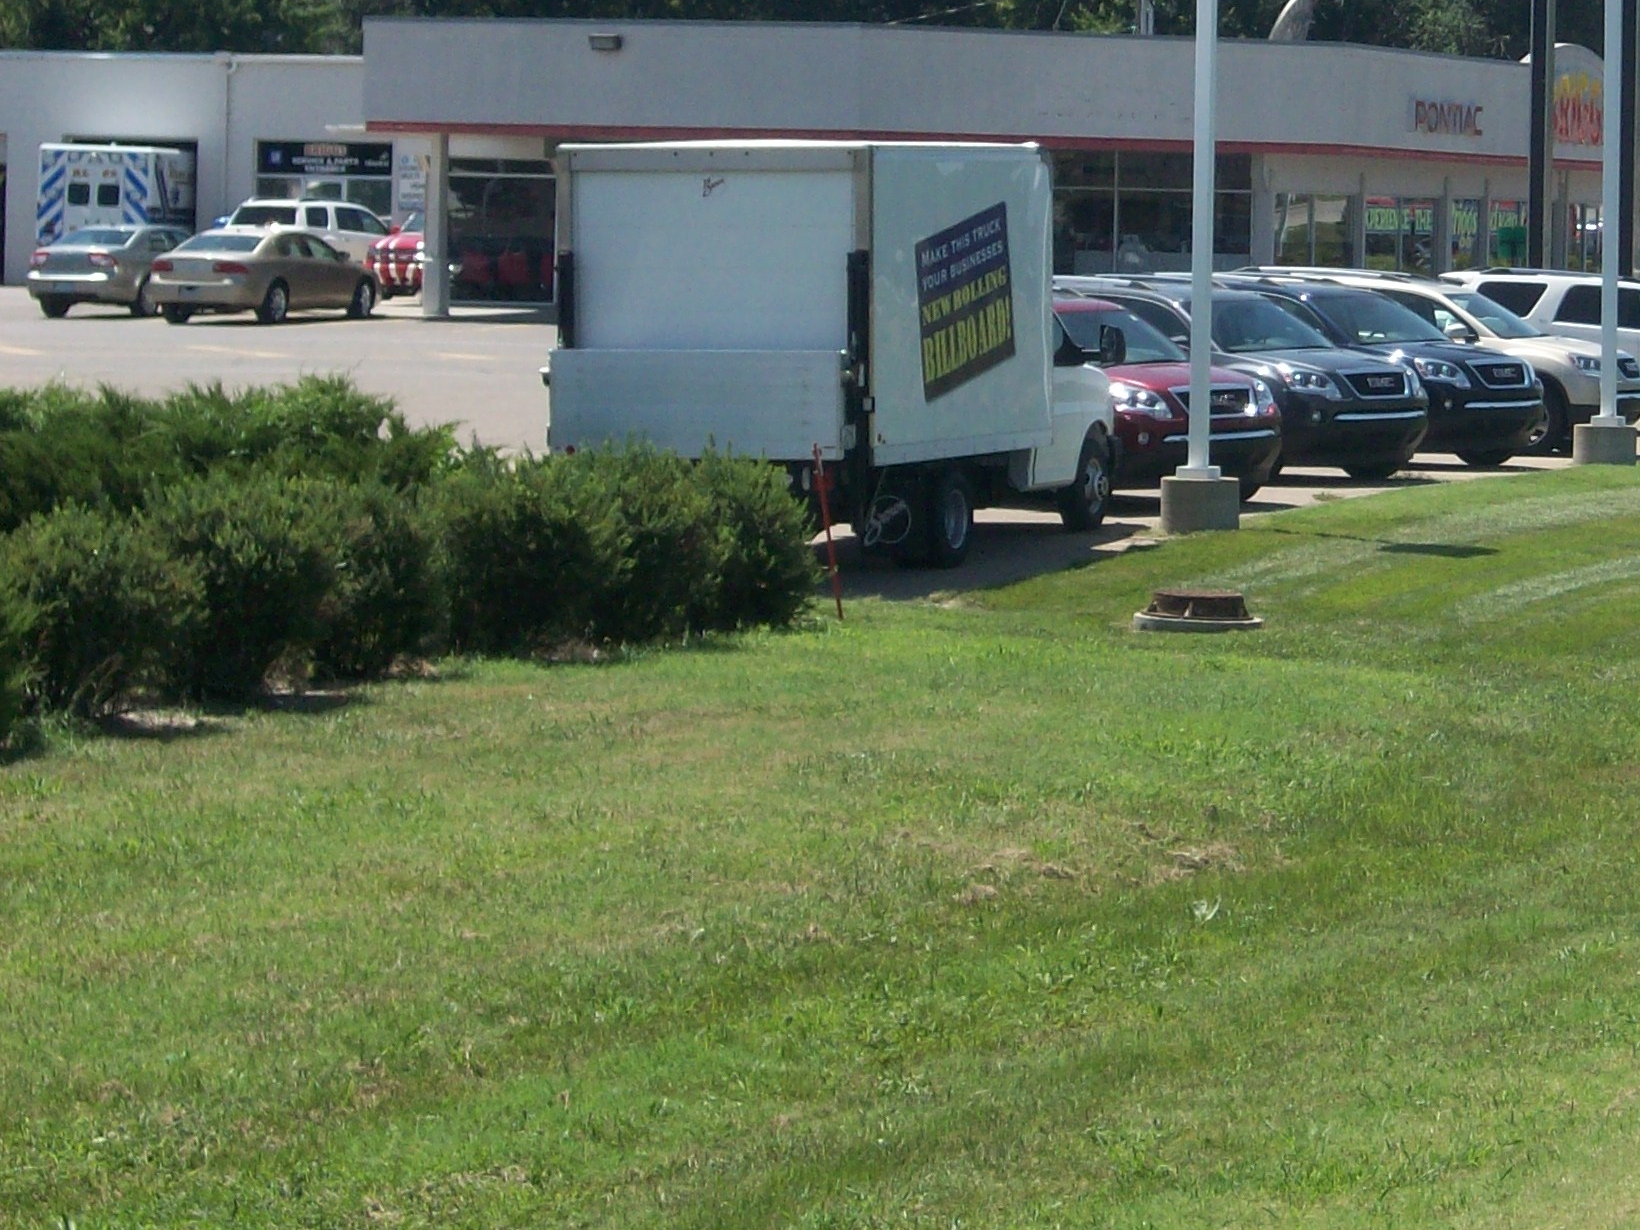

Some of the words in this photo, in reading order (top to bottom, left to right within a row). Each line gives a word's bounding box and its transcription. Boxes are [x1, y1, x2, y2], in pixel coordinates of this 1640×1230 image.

[921, 244, 947, 268] MAKE
[951, 232, 969, 255] THIS
[972, 219, 1001, 244] TRUCK
[922, 269, 948, 292] YOUR
[950, 241, 1003, 279] BUSINESSES
[922, 295, 950, 327] NEW
[953, 266, 1007, 311] ROLLING
[922, 296, 1012, 383] BILLBOARD!
